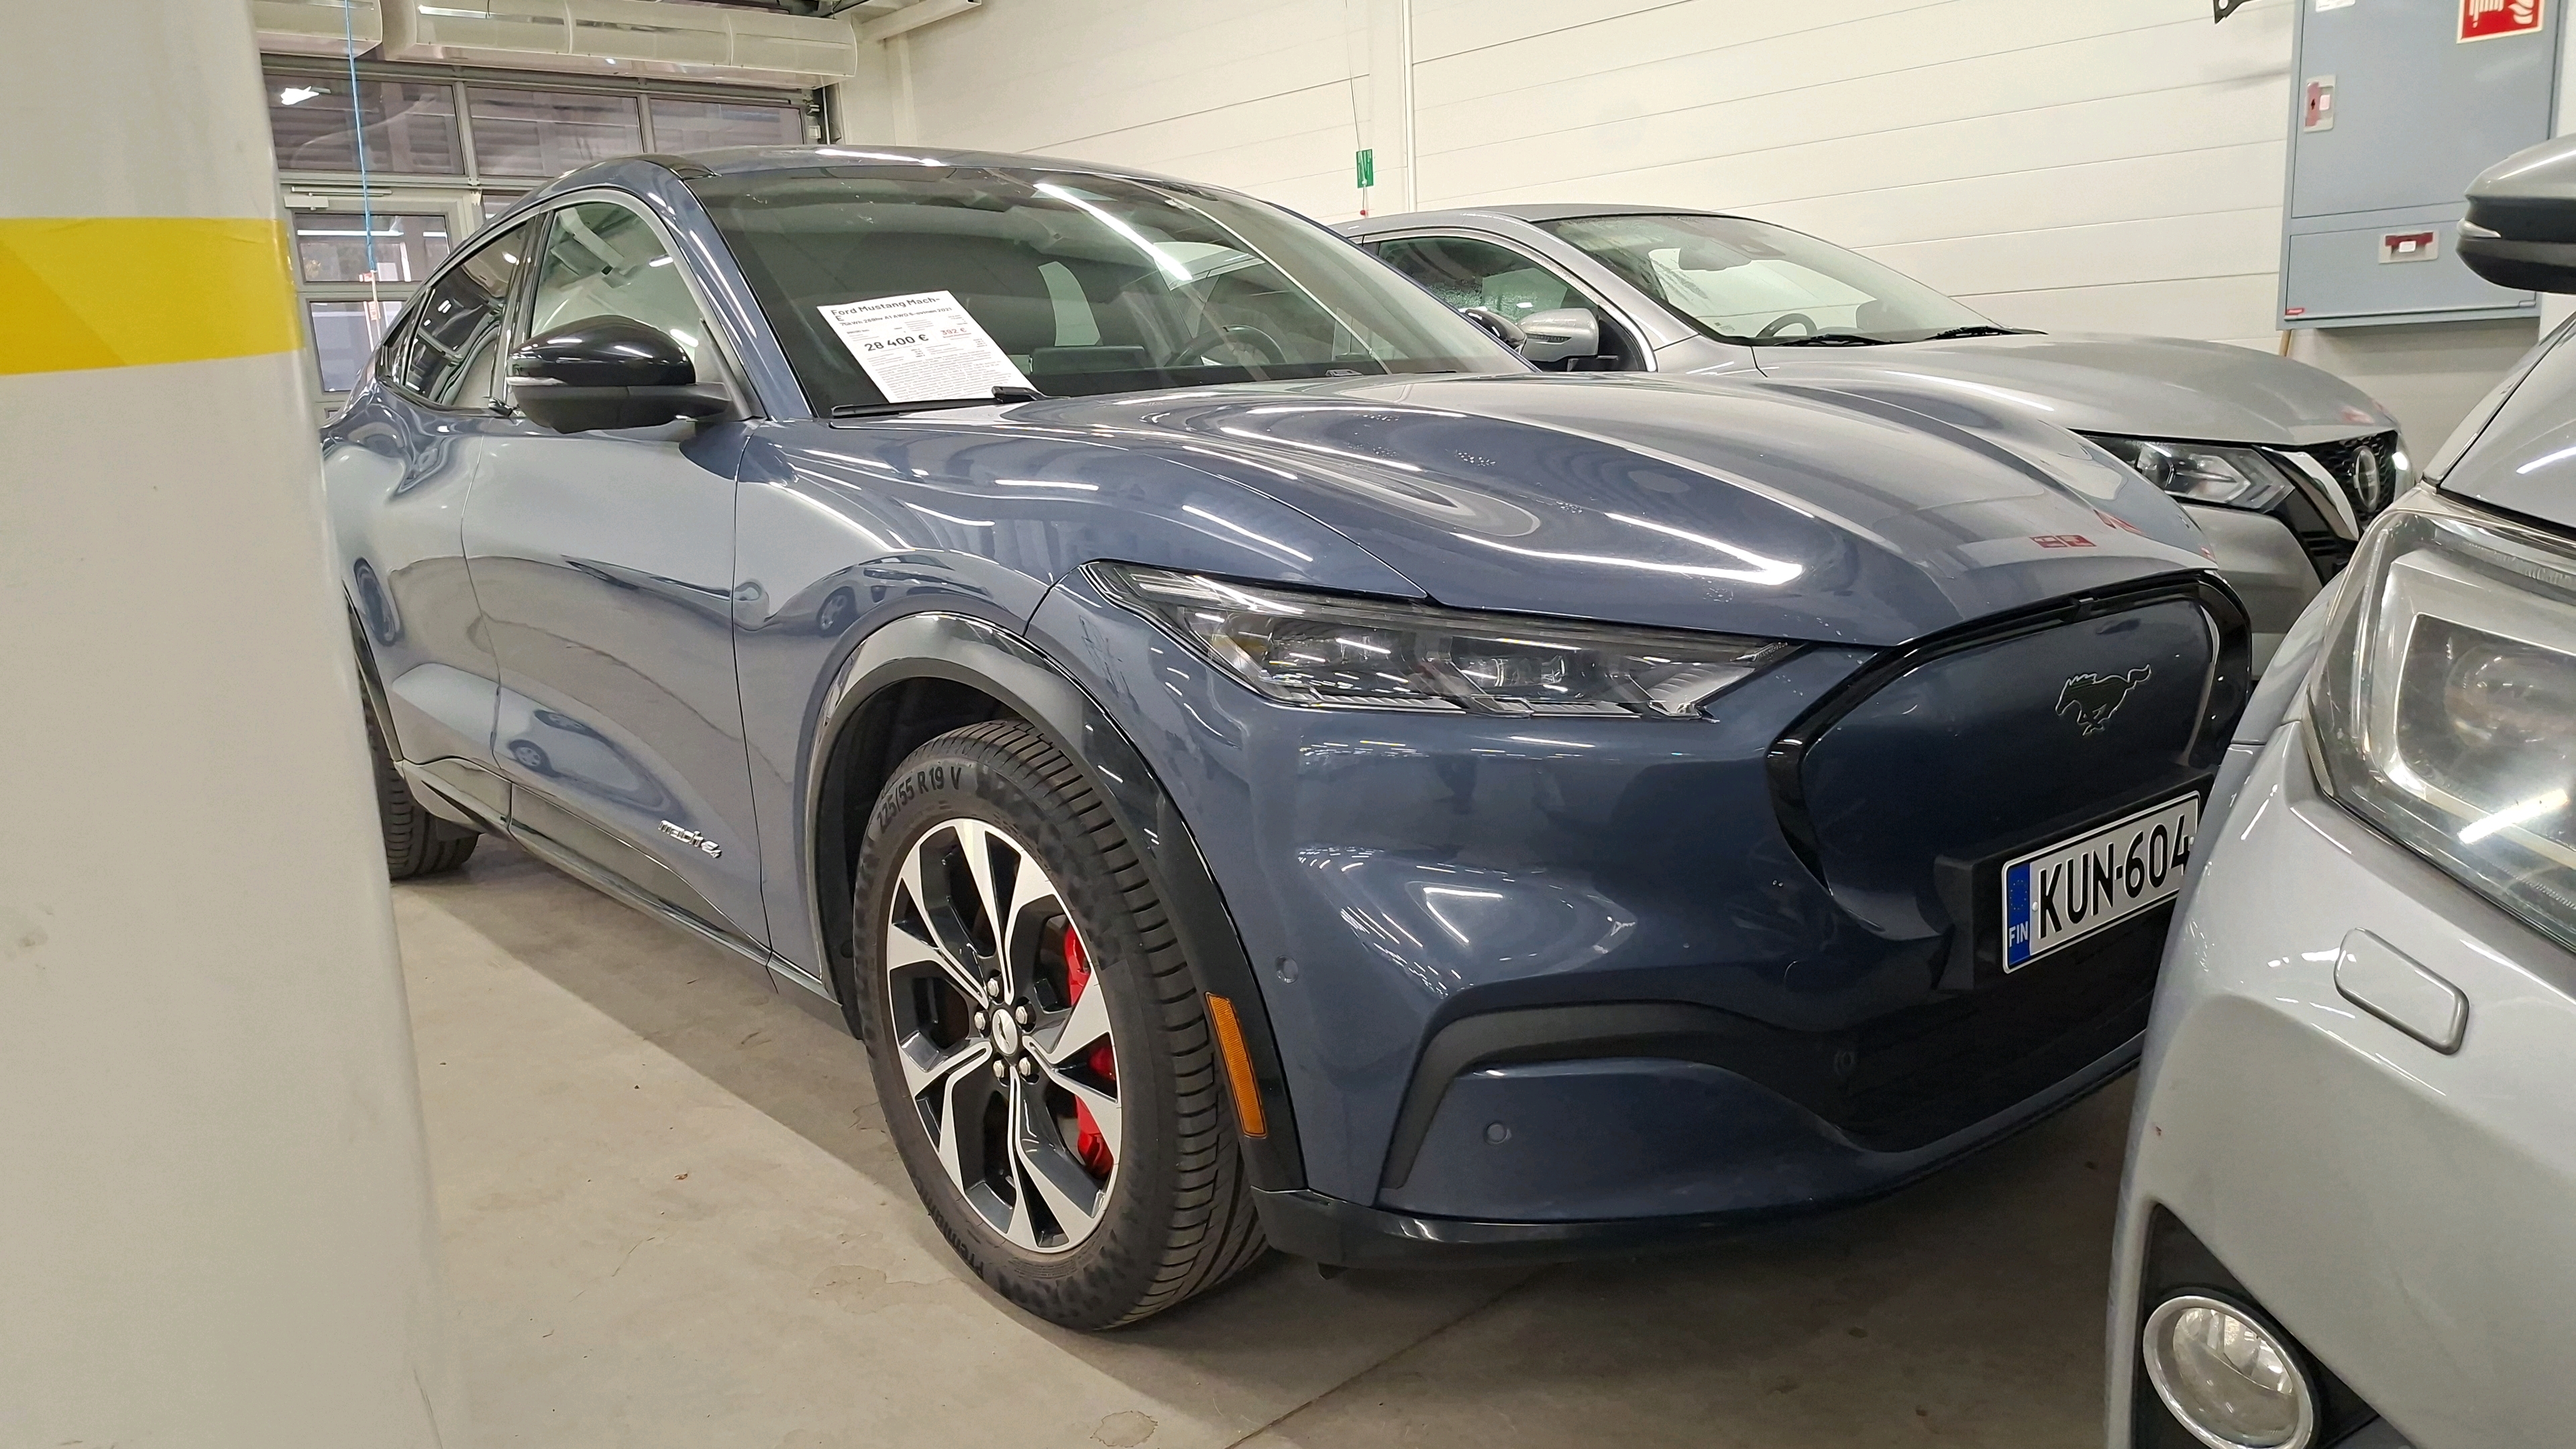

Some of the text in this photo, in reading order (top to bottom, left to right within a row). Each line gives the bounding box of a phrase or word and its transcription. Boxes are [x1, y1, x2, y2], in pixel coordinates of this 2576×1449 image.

[830, 297, 941, 316] Ford Mustang Mach-
[864, 341, 884, 352] 28
[887, 336, 916, 347] 400
[877, 776, 915, 834] 225/55
[2039, 814, 2191, 939] KUN-604
[2008, 920, 2029, 948] FIN
